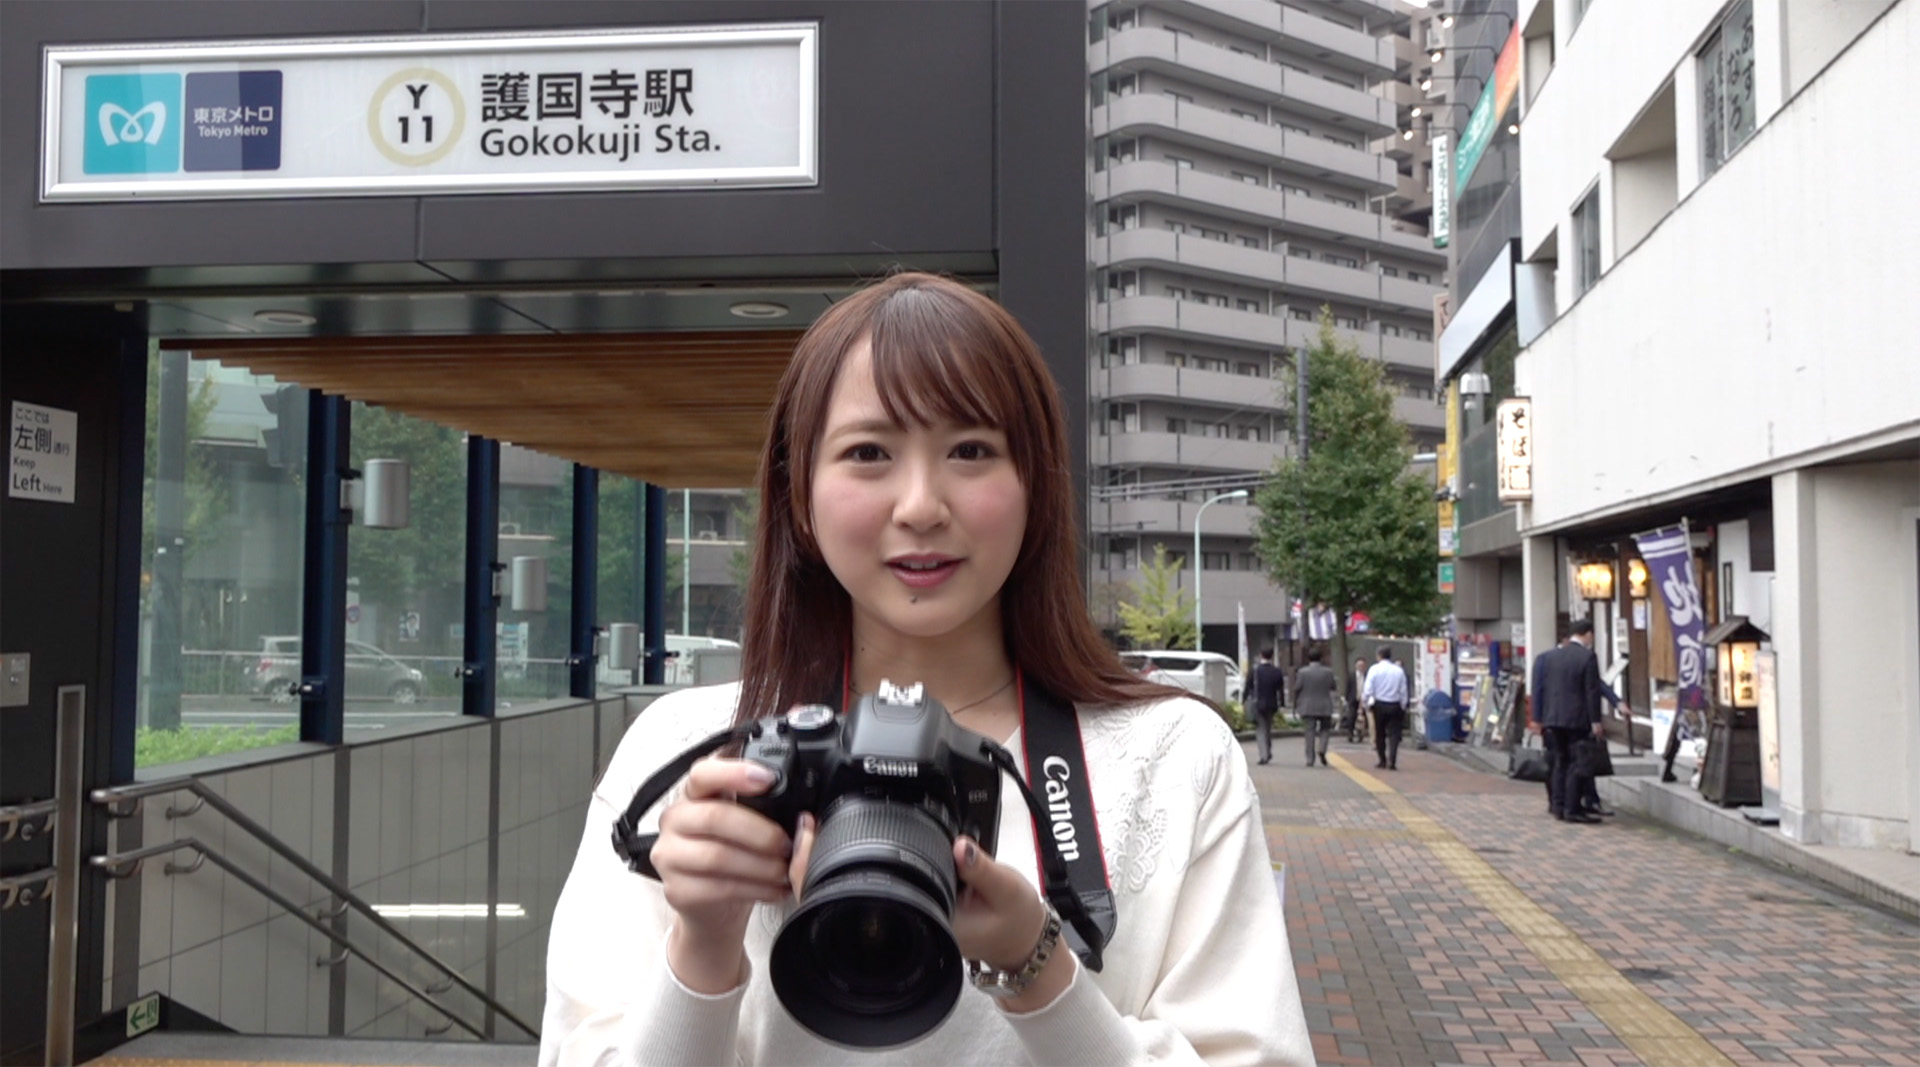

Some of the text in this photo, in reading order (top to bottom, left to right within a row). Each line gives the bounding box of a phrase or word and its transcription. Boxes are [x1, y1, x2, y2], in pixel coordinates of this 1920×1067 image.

[405, 84, 429, 110] Y
[481, 68, 694, 122] 護国寺駅
[193, 106, 273, 124] 東京メトロ
[197, 125, 268, 139] Tokyo Metro
[398, 116, 433, 143] 11
[480, 124, 721, 162] Gokokuji Sta.
[15, 407, 50, 424] ここでは
[1511, 407, 1527, 457] そば
[13, 456, 36, 470] Keep
[13, 472, 62, 494] Left Here
[863, 756, 919, 778] Canon
[1042, 755, 1080, 862] Canon
